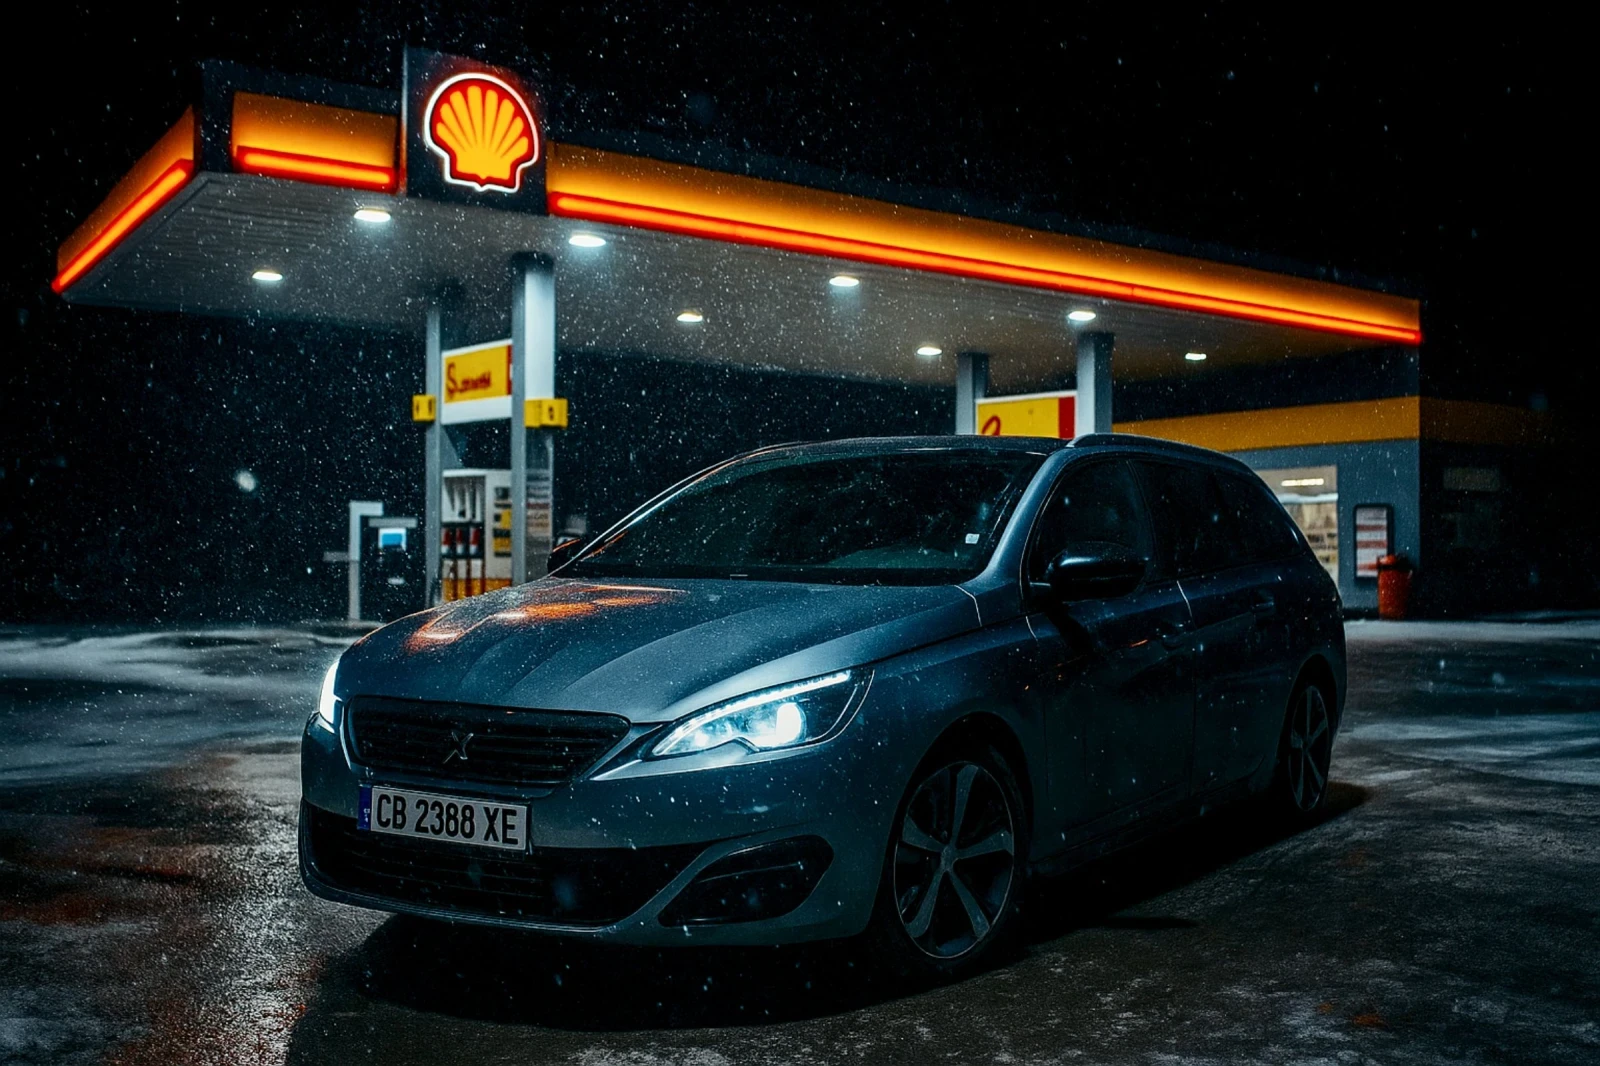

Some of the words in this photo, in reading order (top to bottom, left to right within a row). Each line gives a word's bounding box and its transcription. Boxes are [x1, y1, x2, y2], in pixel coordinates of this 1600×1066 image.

[377, 794, 407, 830] CB
[415, 799, 475, 839] 2388
[483, 806, 519, 845] XE
